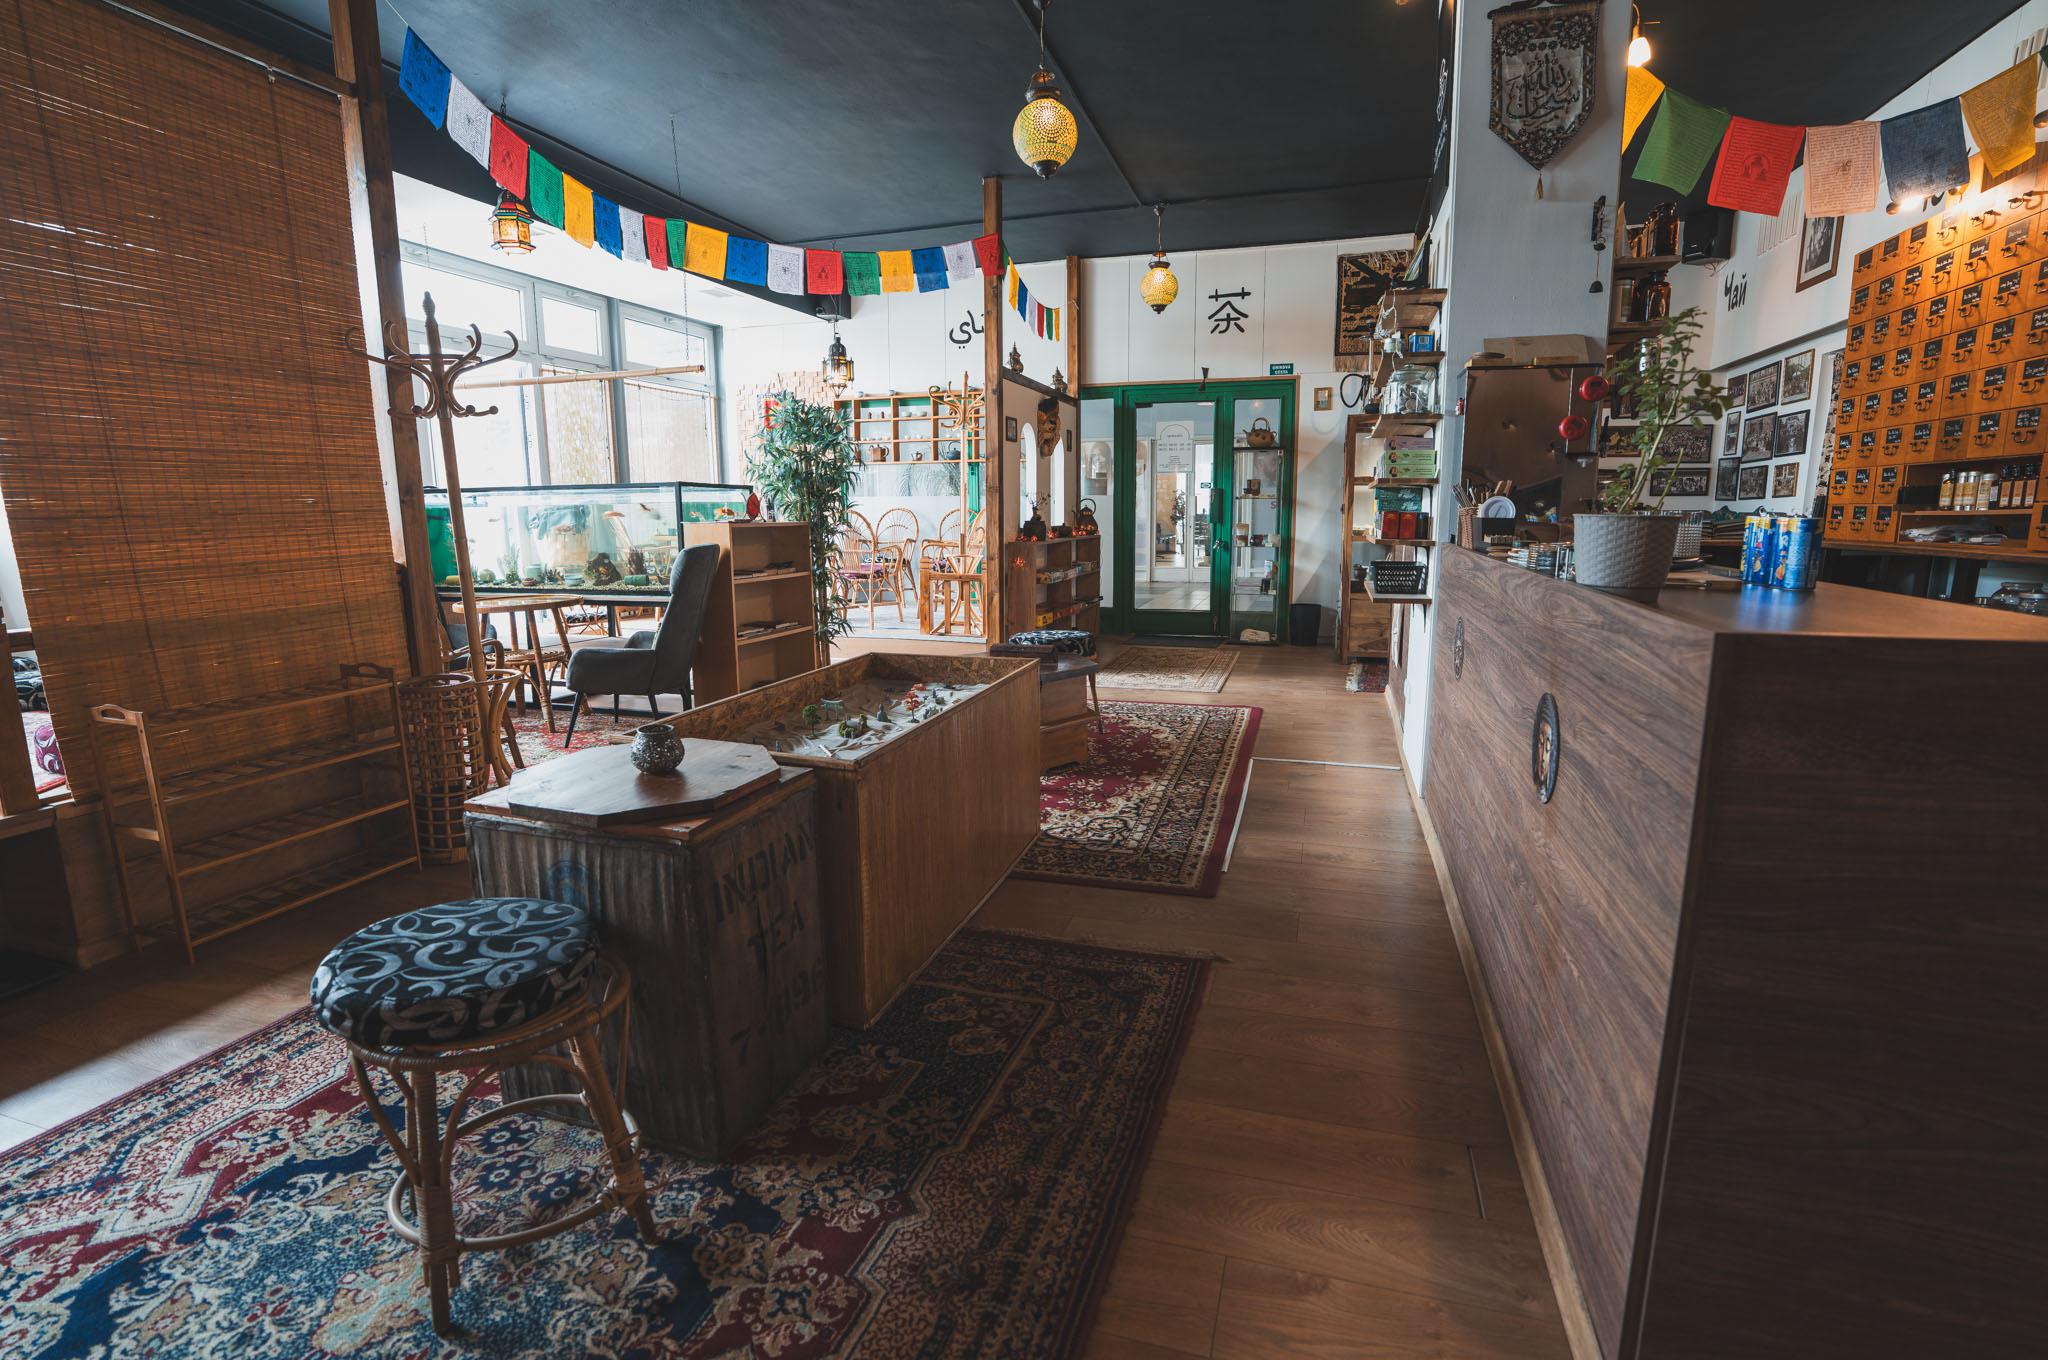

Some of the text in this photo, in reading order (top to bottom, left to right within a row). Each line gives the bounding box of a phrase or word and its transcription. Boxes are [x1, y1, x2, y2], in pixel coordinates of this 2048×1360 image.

[1208, 286, 1251, 334] 茶
[1724, 271, 1748, 312] Чай
[713, 818, 816, 923] INDIAN
[746, 900, 806, 973] TEA
